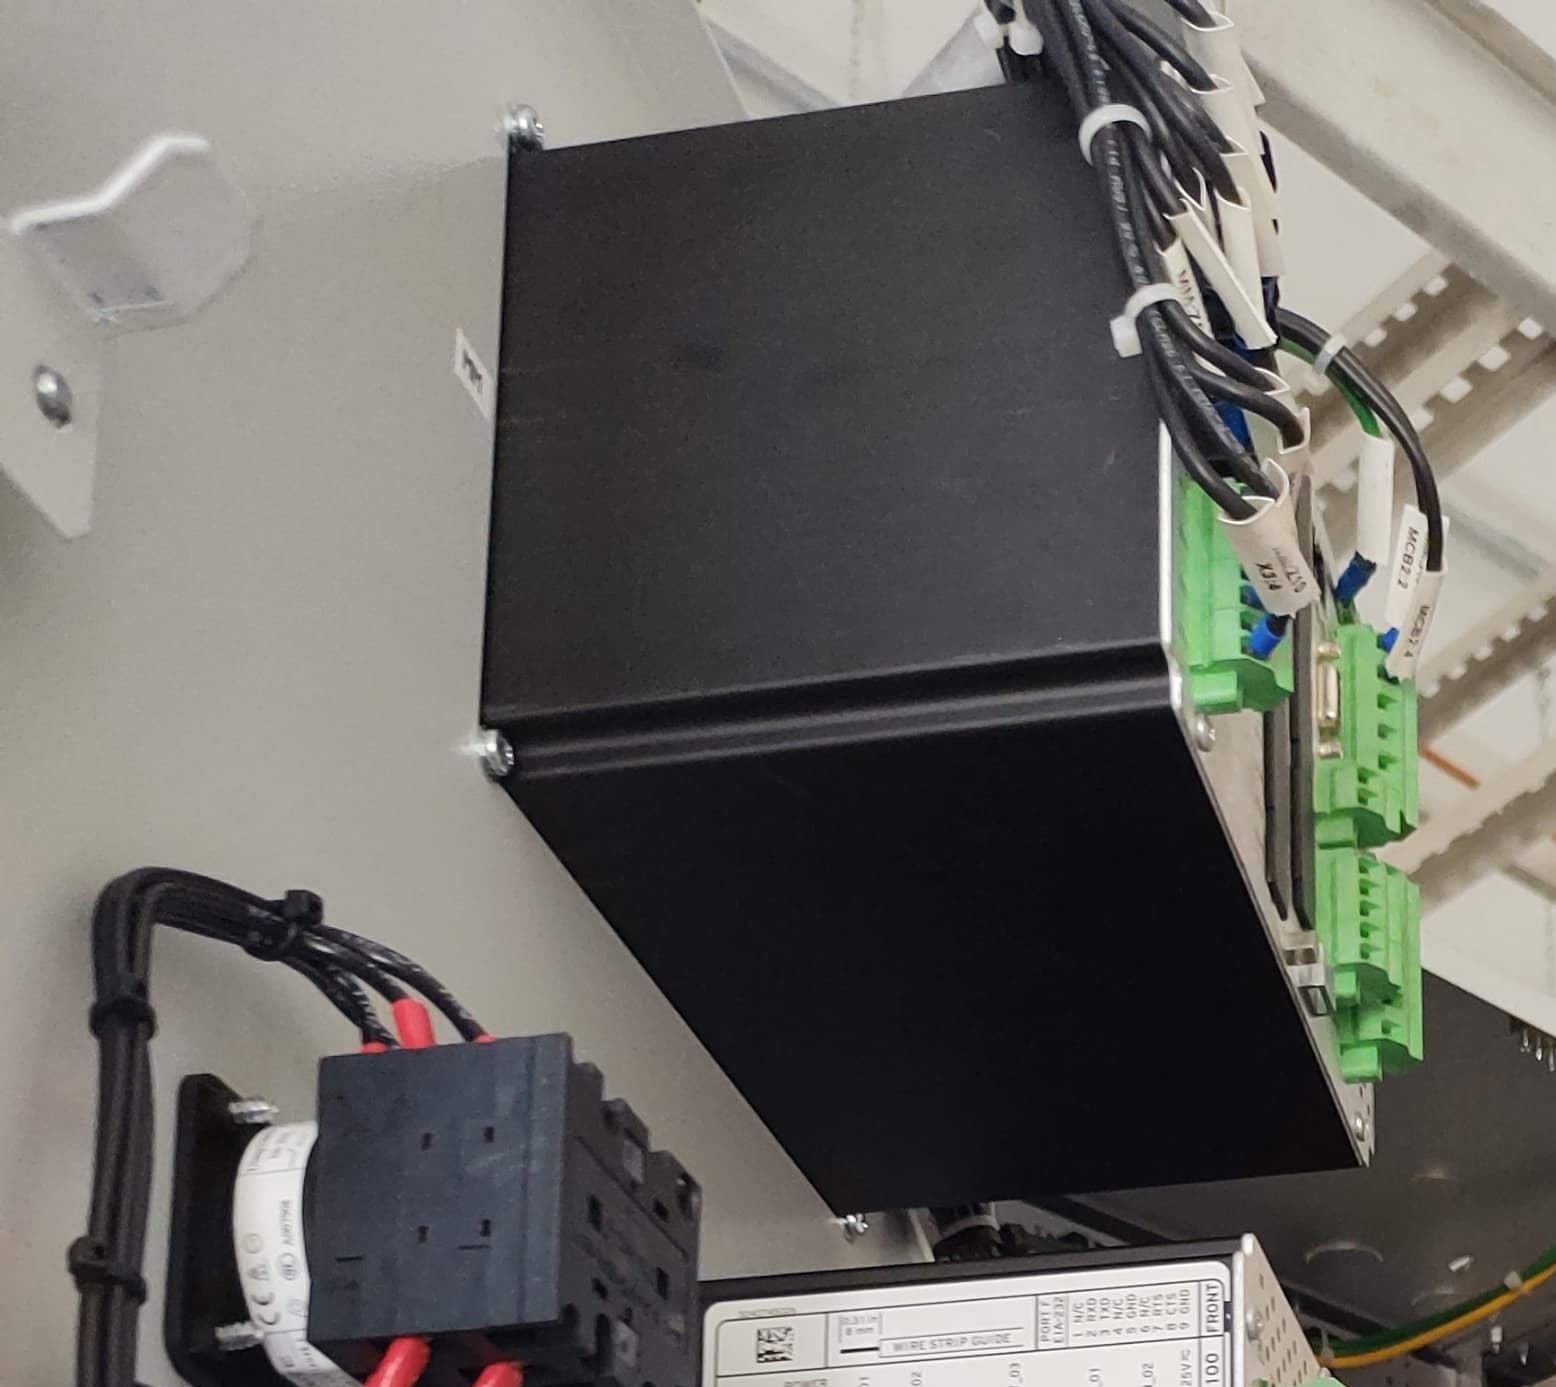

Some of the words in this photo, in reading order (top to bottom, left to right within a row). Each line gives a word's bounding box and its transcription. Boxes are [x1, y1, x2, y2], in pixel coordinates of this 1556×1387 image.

[1206, 1284, 1219, 1333] FRONT
[971, 1333, 1011, 1346] GUIDE
[1040, 1318, 1051, 1342] PORT
[1205, 1353, 1219, 1383] 100
